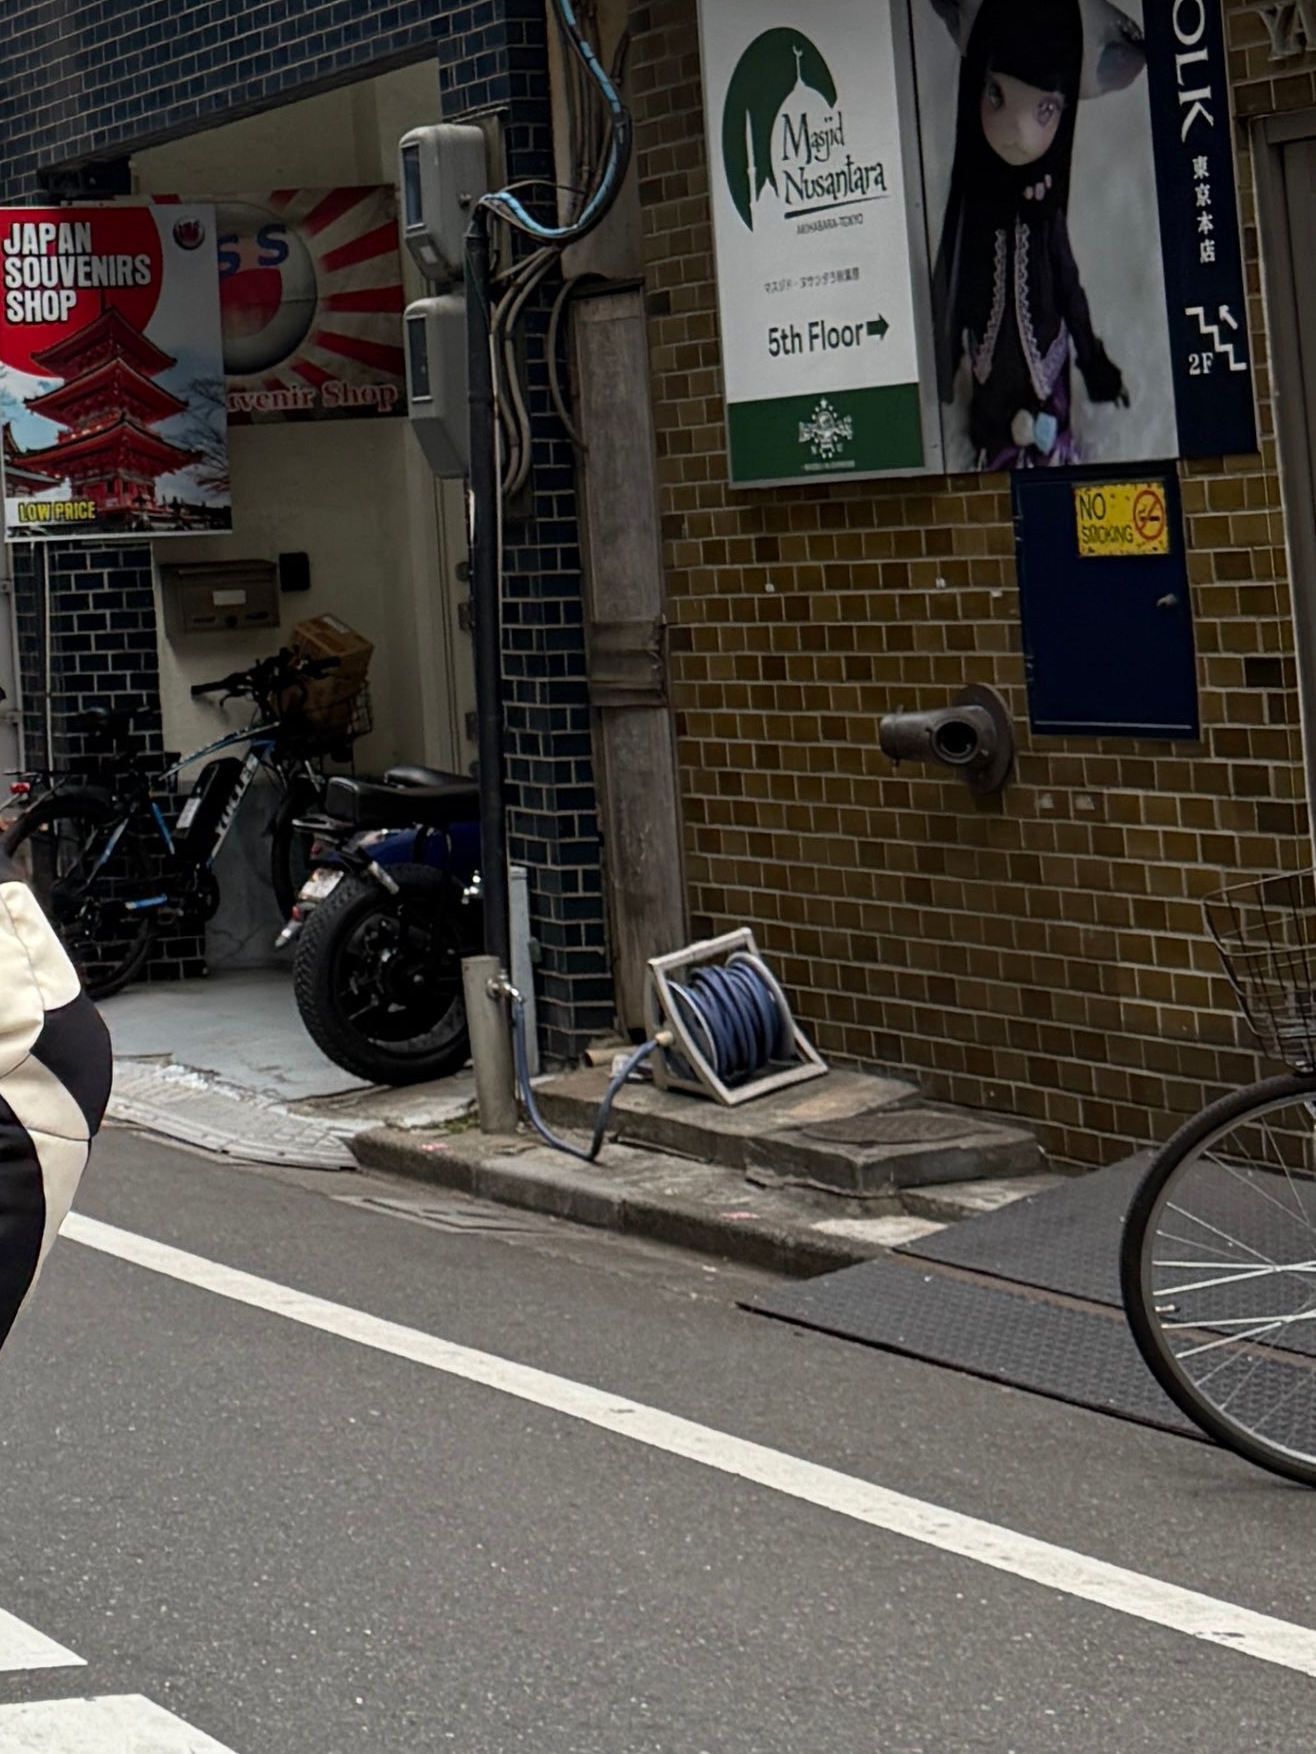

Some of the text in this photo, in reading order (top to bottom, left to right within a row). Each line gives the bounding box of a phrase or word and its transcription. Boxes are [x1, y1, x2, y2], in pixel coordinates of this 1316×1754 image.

[781, 110, 846, 165] Masjid
[782, 153, 888, 206] Nusantara
[1191, 154, 1217, 264] 東京本店
[2, 221, 92, 256] JAPAN
[3, 253, 152, 289] SOUVENIRS
[5, 289, 77, 323] SHOP
[767, 319, 864, 357] 5th Floor
[1188, 352, 1214, 376] 2F
[320, 379, 398, 413] Shop
[18, 499, 97, 523] LOW PRICE
[1079, 492, 1106, 522] NO
